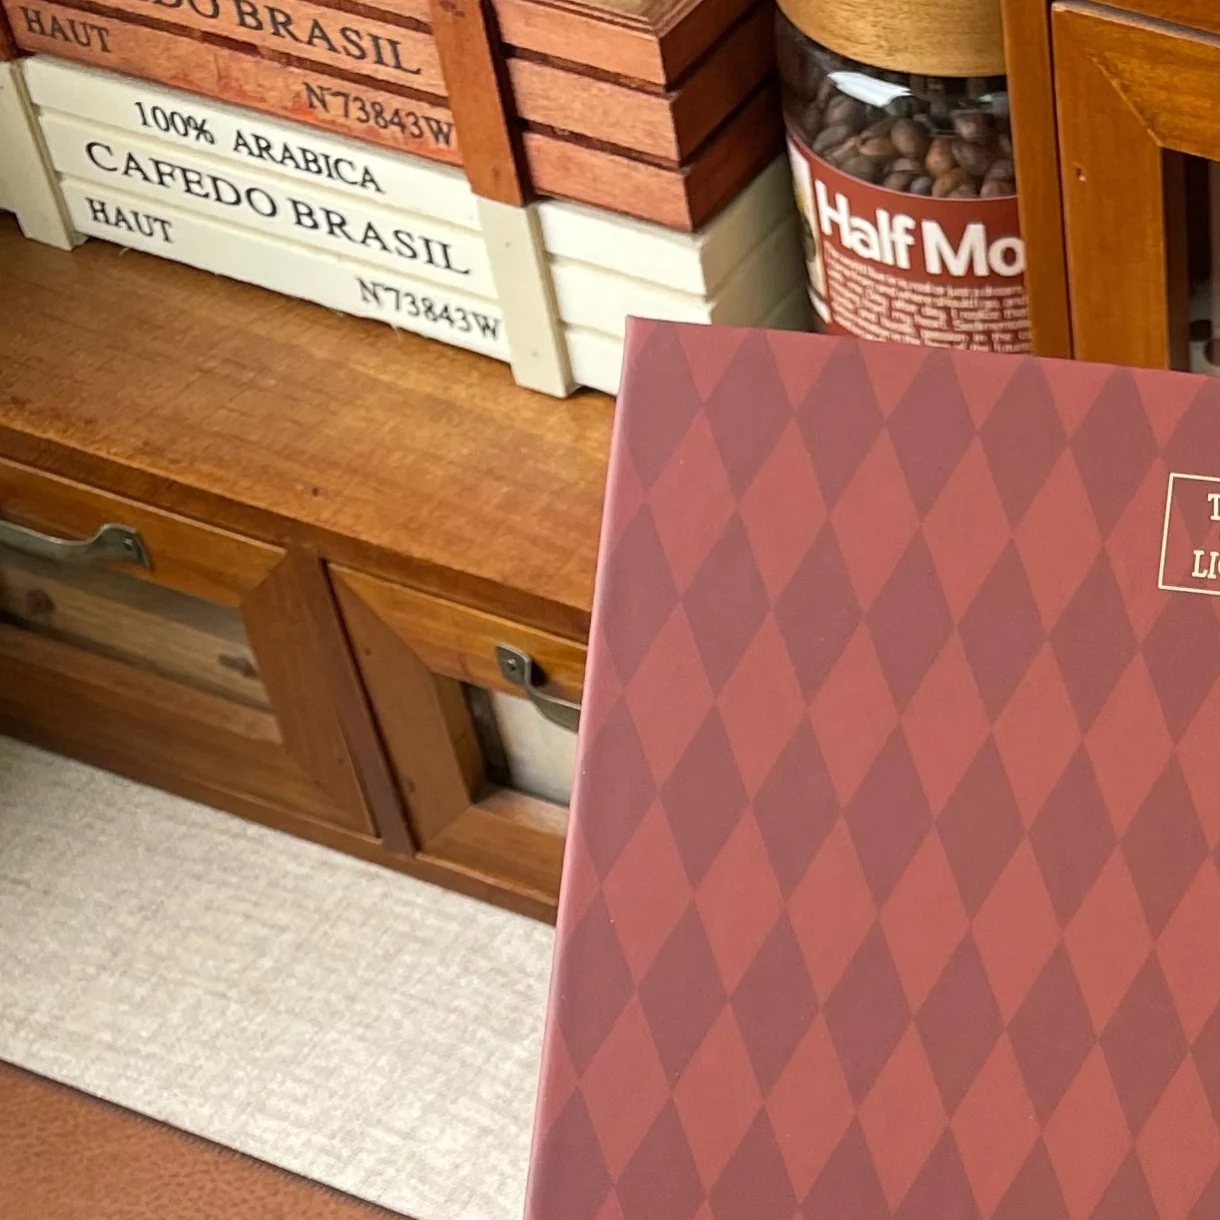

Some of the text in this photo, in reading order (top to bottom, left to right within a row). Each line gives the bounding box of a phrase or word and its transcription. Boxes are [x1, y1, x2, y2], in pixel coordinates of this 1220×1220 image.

[19, 5, 111, 54] HAUT
[236, 0, 422, 75] BRASIL
[134, 101, 386, 194] 100% ARABICA
[85, 141, 471, 276] CAFEDO BRASIL
[86, 197, 174, 244] HAUT
[815, 178, 916, 270] Half
